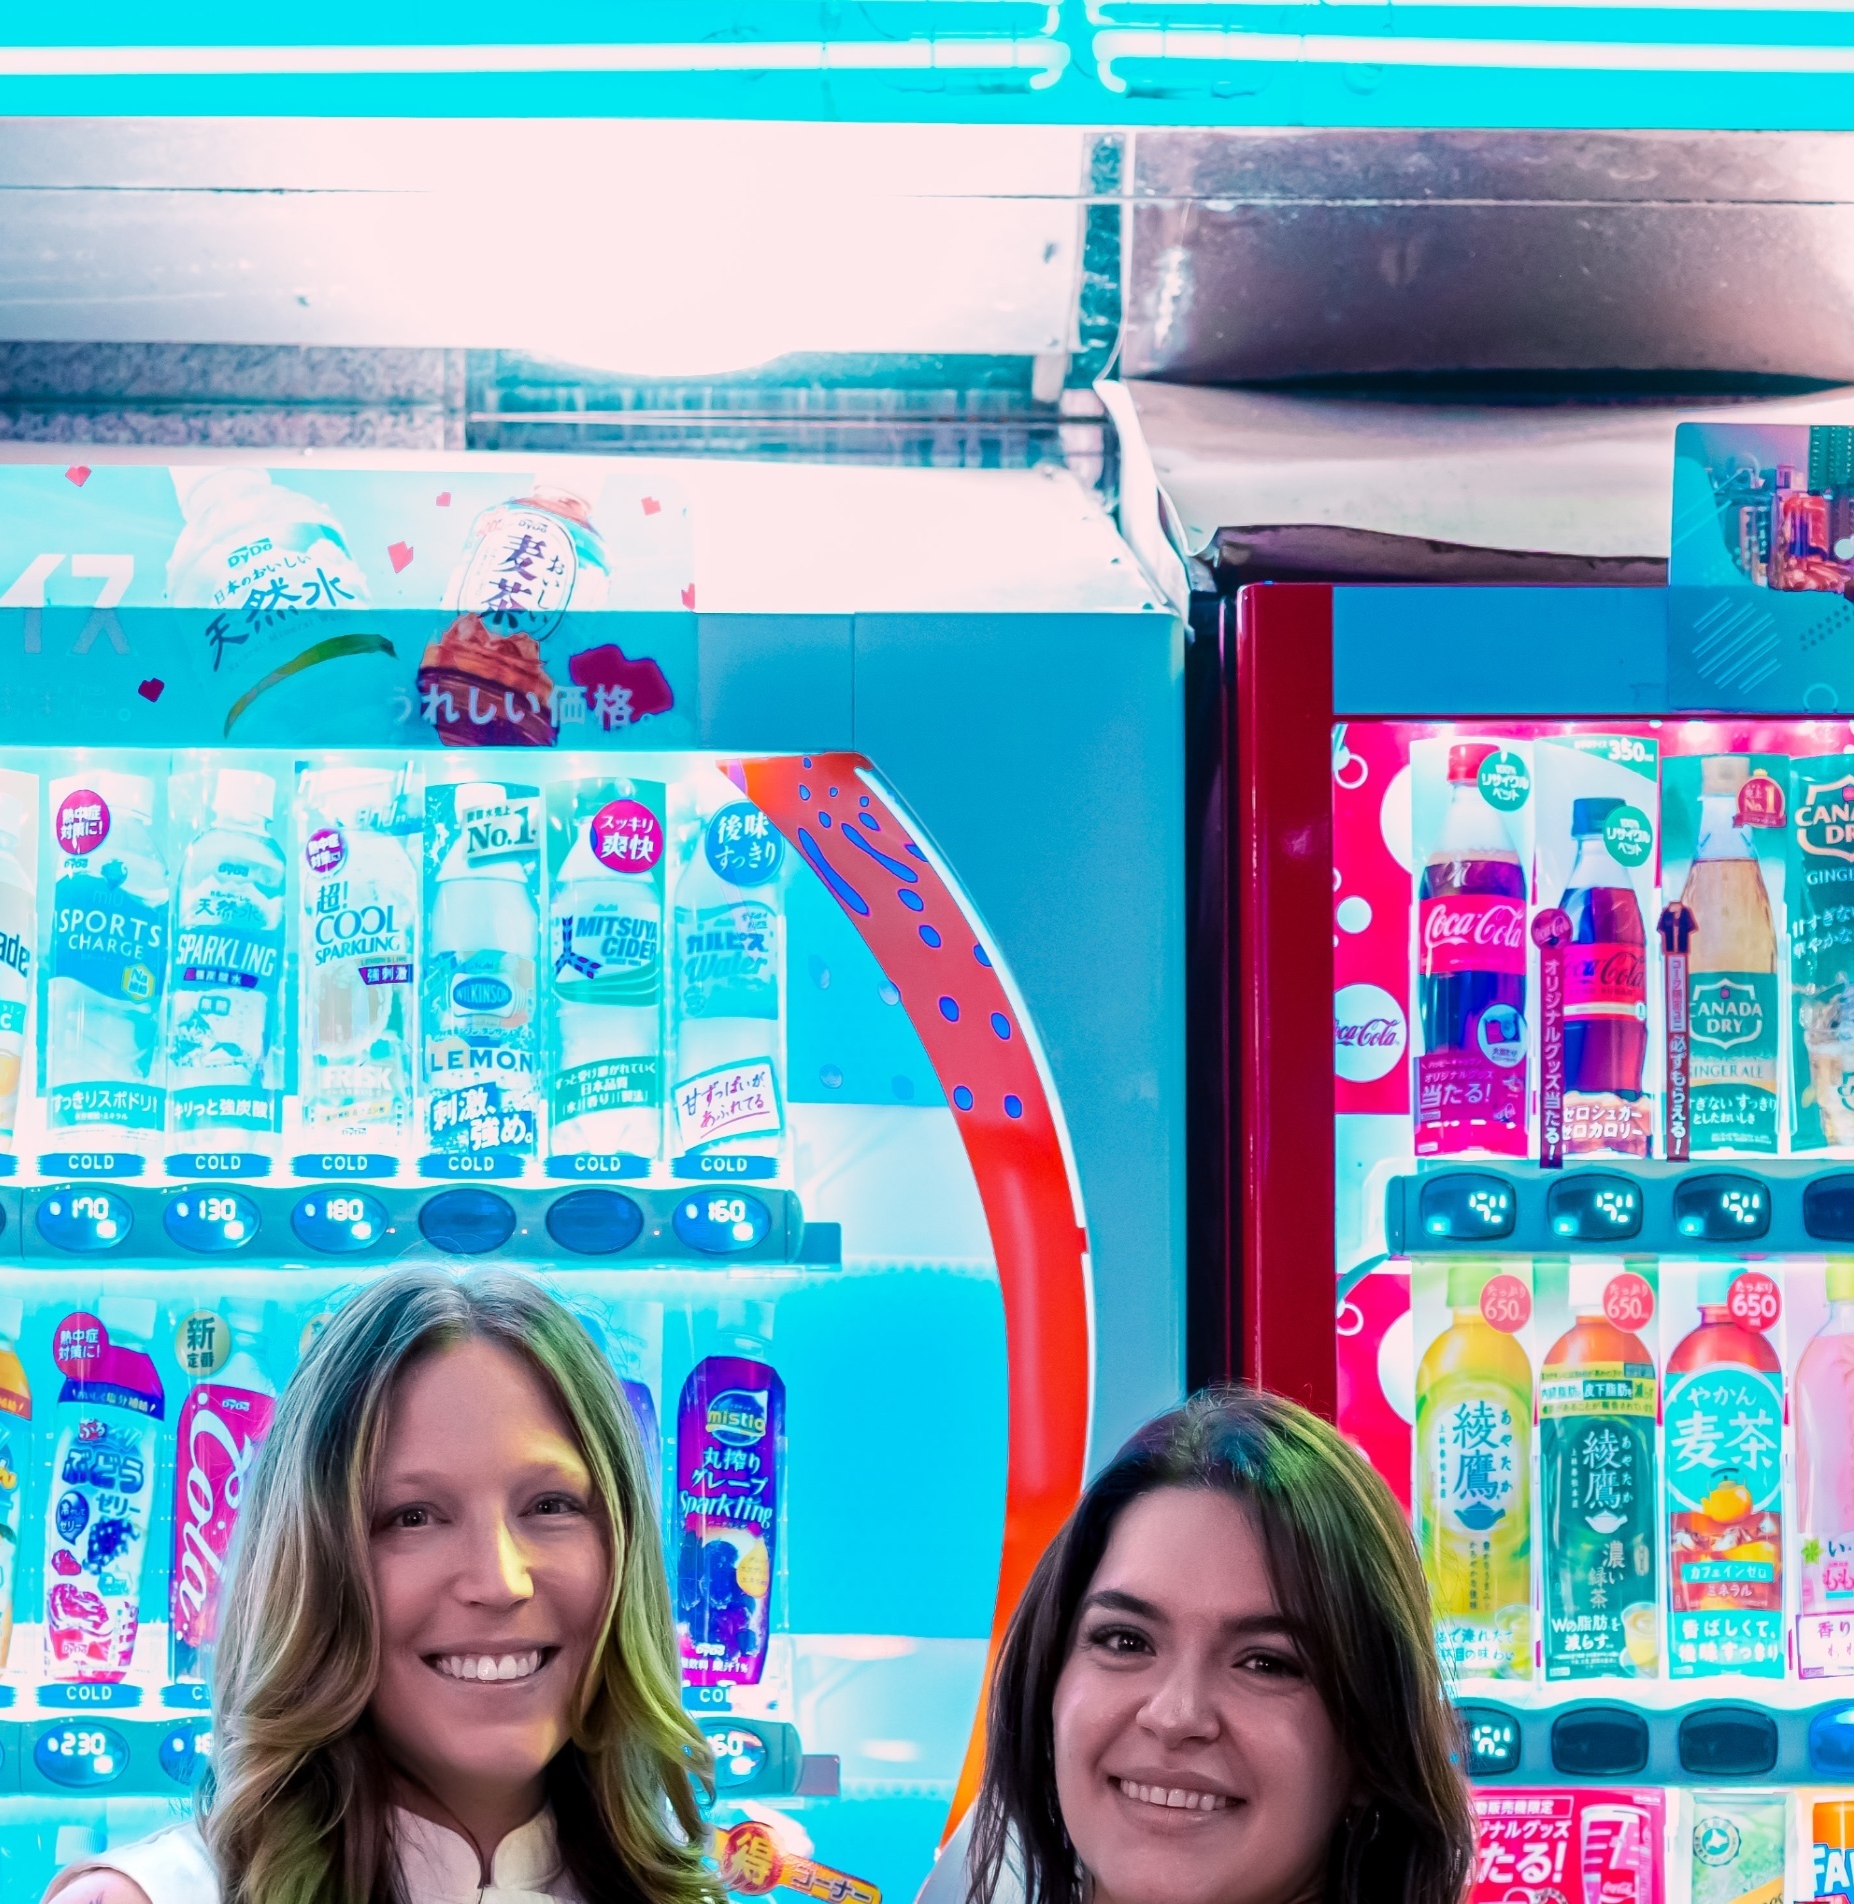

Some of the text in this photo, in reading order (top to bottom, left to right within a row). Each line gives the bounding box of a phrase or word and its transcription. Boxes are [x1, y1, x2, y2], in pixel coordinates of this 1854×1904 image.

[226, 537, 275, 569] DyDo
[481, 534, 548, 630] 麦茶
[205, 567, 356, 672] 天然水
[600, 814, 654, 834] スッキリ
[718, 815, 769, 841] 後味
[602, 835, 656, 863] 爽快
[57, 910, 163, 948] SPORTS
[315, 905, 399, 946] COOL
[1424, 903, 1524, 949] Coca-Cola
[67, 933, 144, 961] CHARGE
[175, 934, 277, 978] SPARKLING
[314, 936, 401, 966] SPARKLING
[601, 938, 657, 960] CIDER
[1706, 1018, 1743, 1034] DRY
[430, 1048, 534, 1075] LEMON
[68, 1154, 115, 1171] COLD
[195, 1154, 242, 1172] COLD
[321, 1155, 368, 1172] COLD
[448, 1156, 495, 1172] COLD
[574, 1156, 622, 1172] COLD
[700, 1156, 748, 1173] COLD
[71, 1198, 110, 1220] 170
[198, 1199, 237, 1220] 130
[325, 1200, 364, 1221] 180
[707, 1200, 747, 1222] 160
[186, 1316, 217, 1353] 新
[1688, 1385, 1757, 1408] やかん
[1671, 1410, 1776, 1473] 麦茶
[61, 1448, 145, 1493] ぶどう
[95, 1493, 141, 1517] ゼリー
[679, 1492, 773, 1530] Sparkling
[60, 1732, 106, 1756] 230
